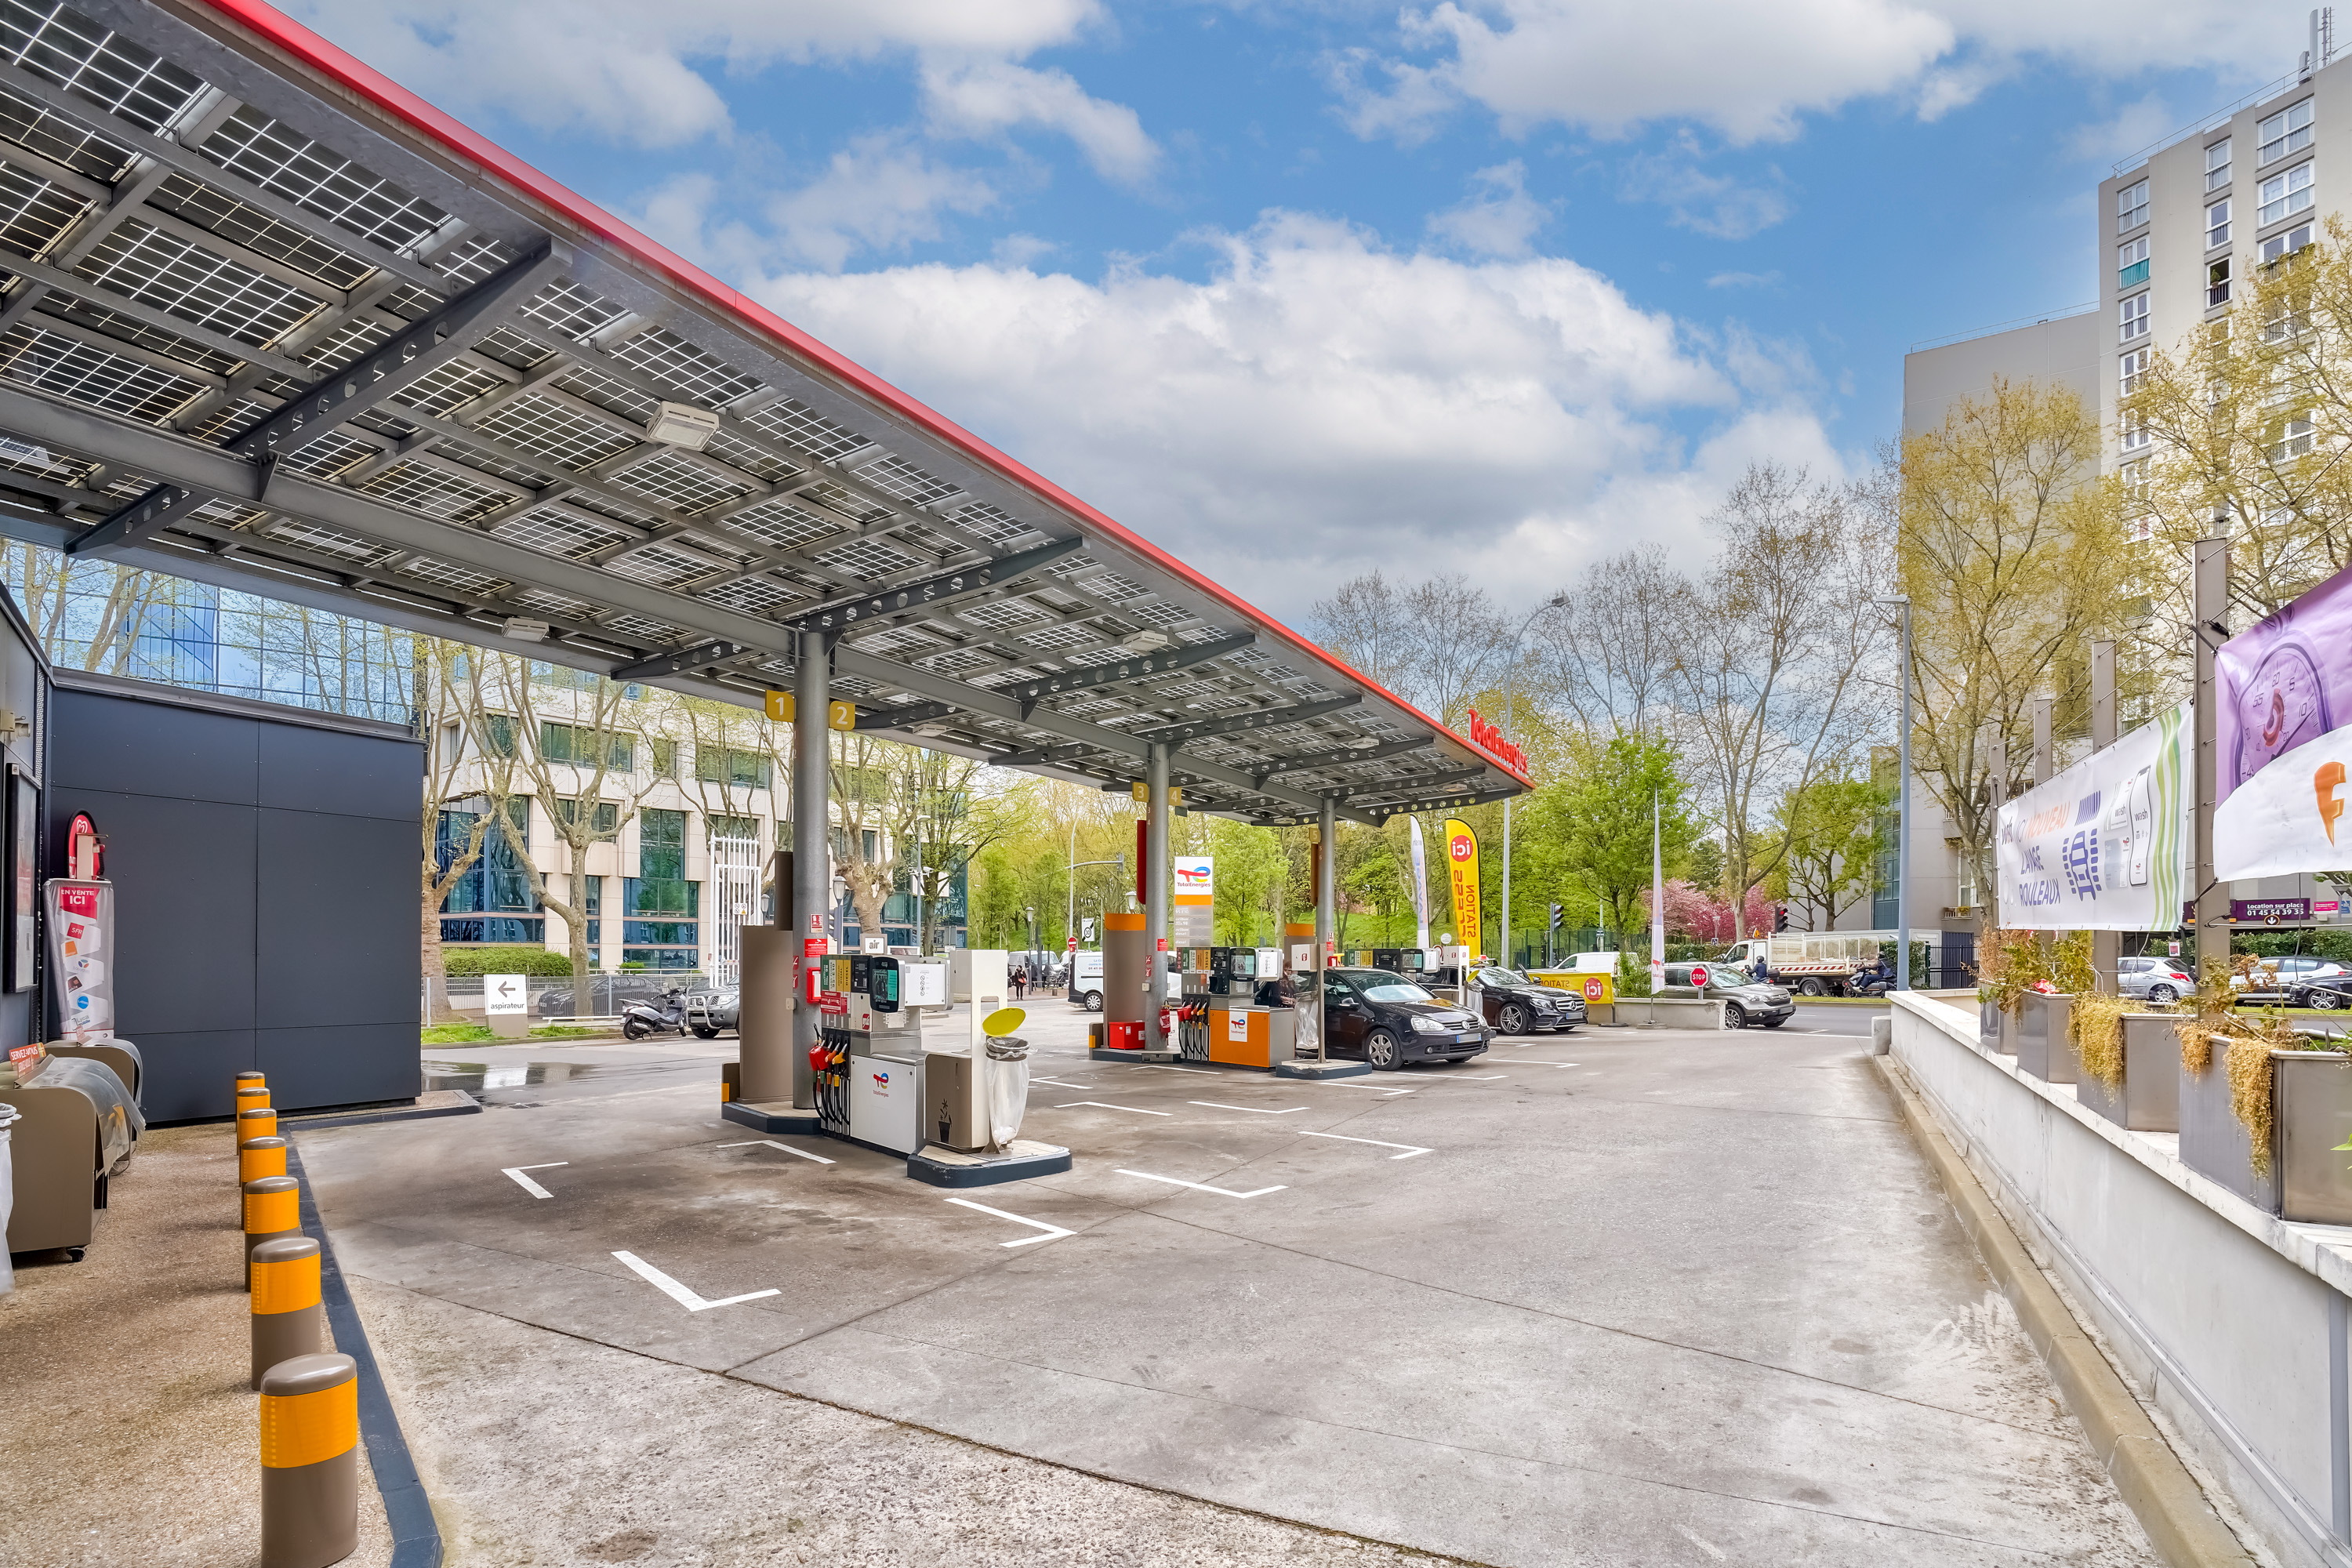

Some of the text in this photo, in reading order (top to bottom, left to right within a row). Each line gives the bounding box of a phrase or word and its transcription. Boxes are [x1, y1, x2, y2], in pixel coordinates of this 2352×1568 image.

[775, 697, 783, 716] 1
[837, 706, 848, 724] 2
[1138, 786, 1144, 798] 3
[1171, 790, 1178, 802] 4
[2115, 806, 2126, 817] wash
[2135, 808, 2148, 822] wash
[2026, 800, 2071, 840] NOUVEAU
[1312, 831, 1317, 840] 5
[1336, 832, 1340, 841] 6
[2020, 877, 2061, 906] ROULEAUX
[70, 895, 85, 905] ICI
[869, 939, 880, 949] air
[490, 1002, 524, 1011] aspirateur
[10, 1046, 38, 1061] SERVEZ-VOUS
